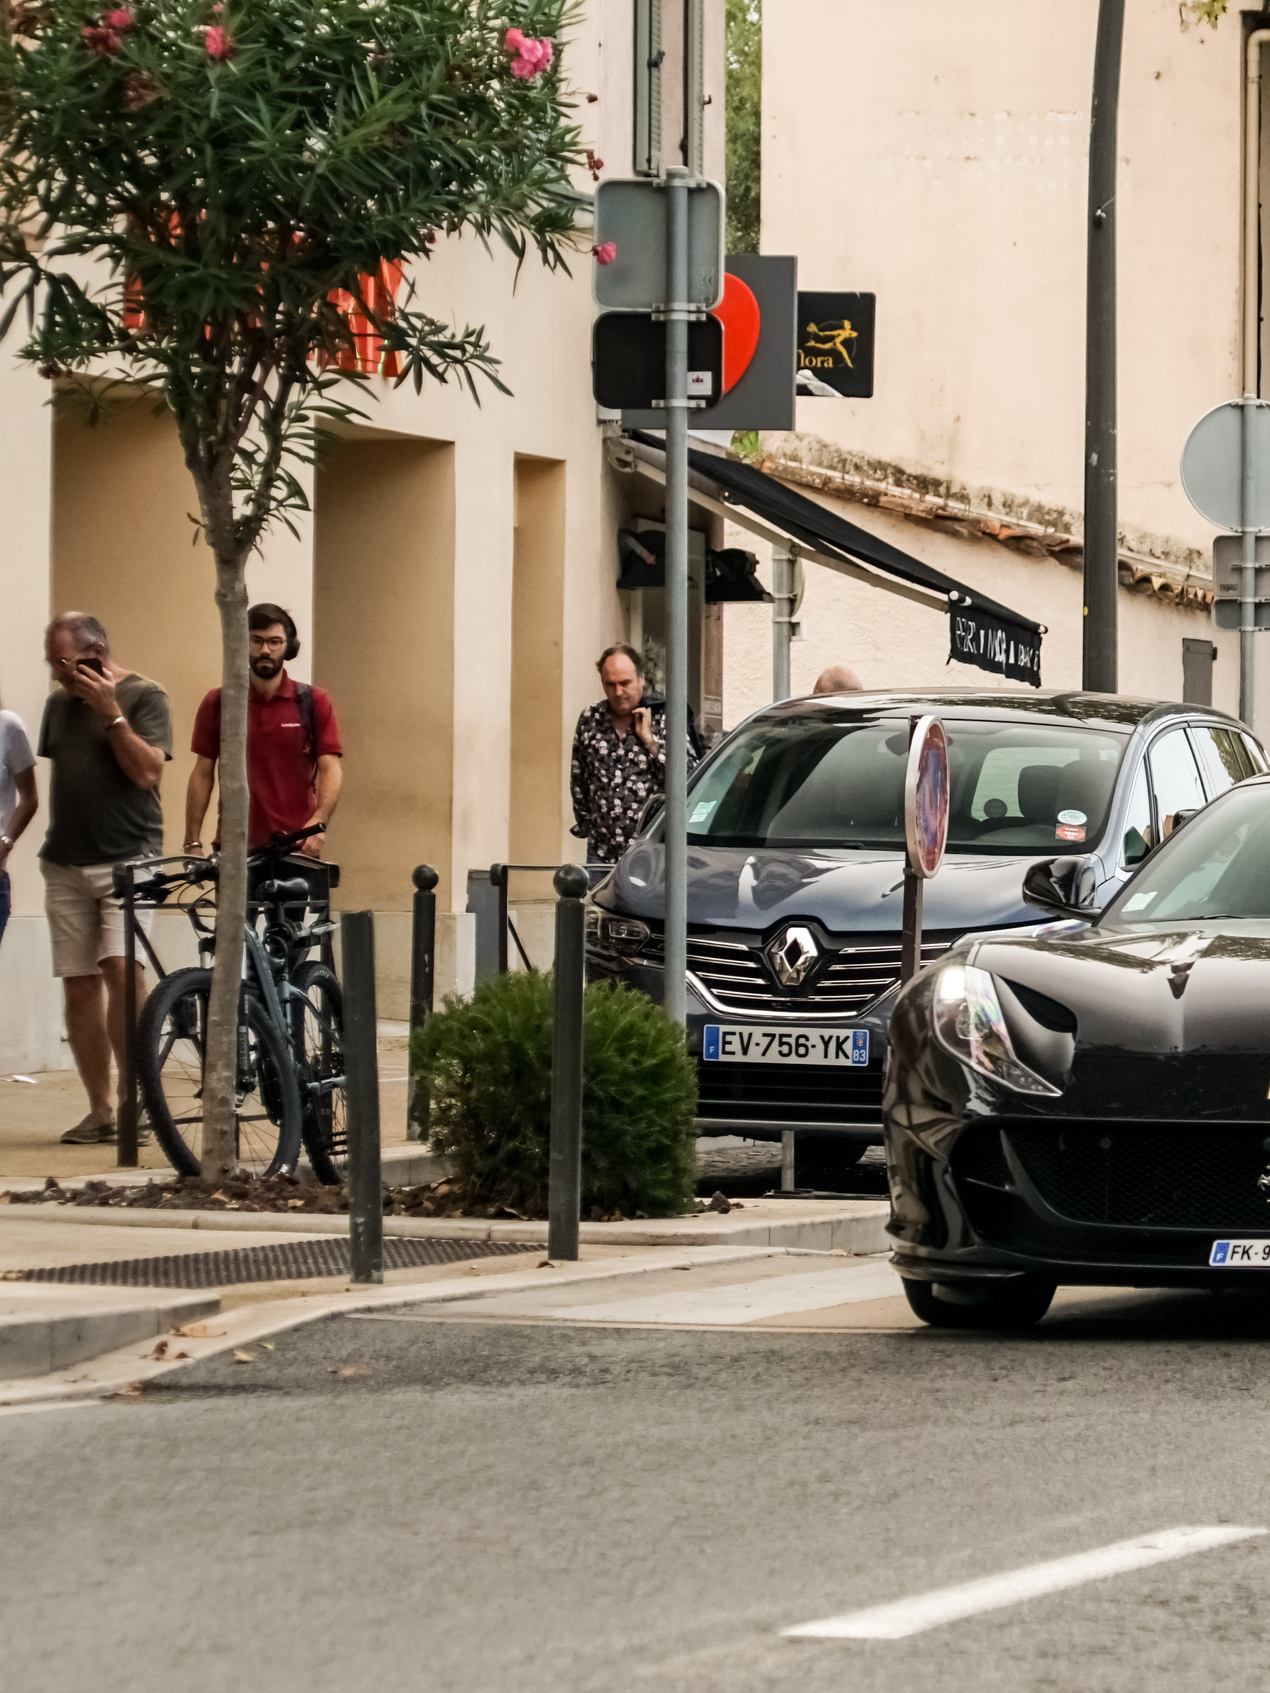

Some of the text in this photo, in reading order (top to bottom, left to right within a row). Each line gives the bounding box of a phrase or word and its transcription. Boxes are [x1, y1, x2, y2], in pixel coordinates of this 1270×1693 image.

[797, 350, 834, 368] lora
[710, 1031, 866, 1062] F EV-756-YK 83
[1216, 1253, 1224, 1261] F
